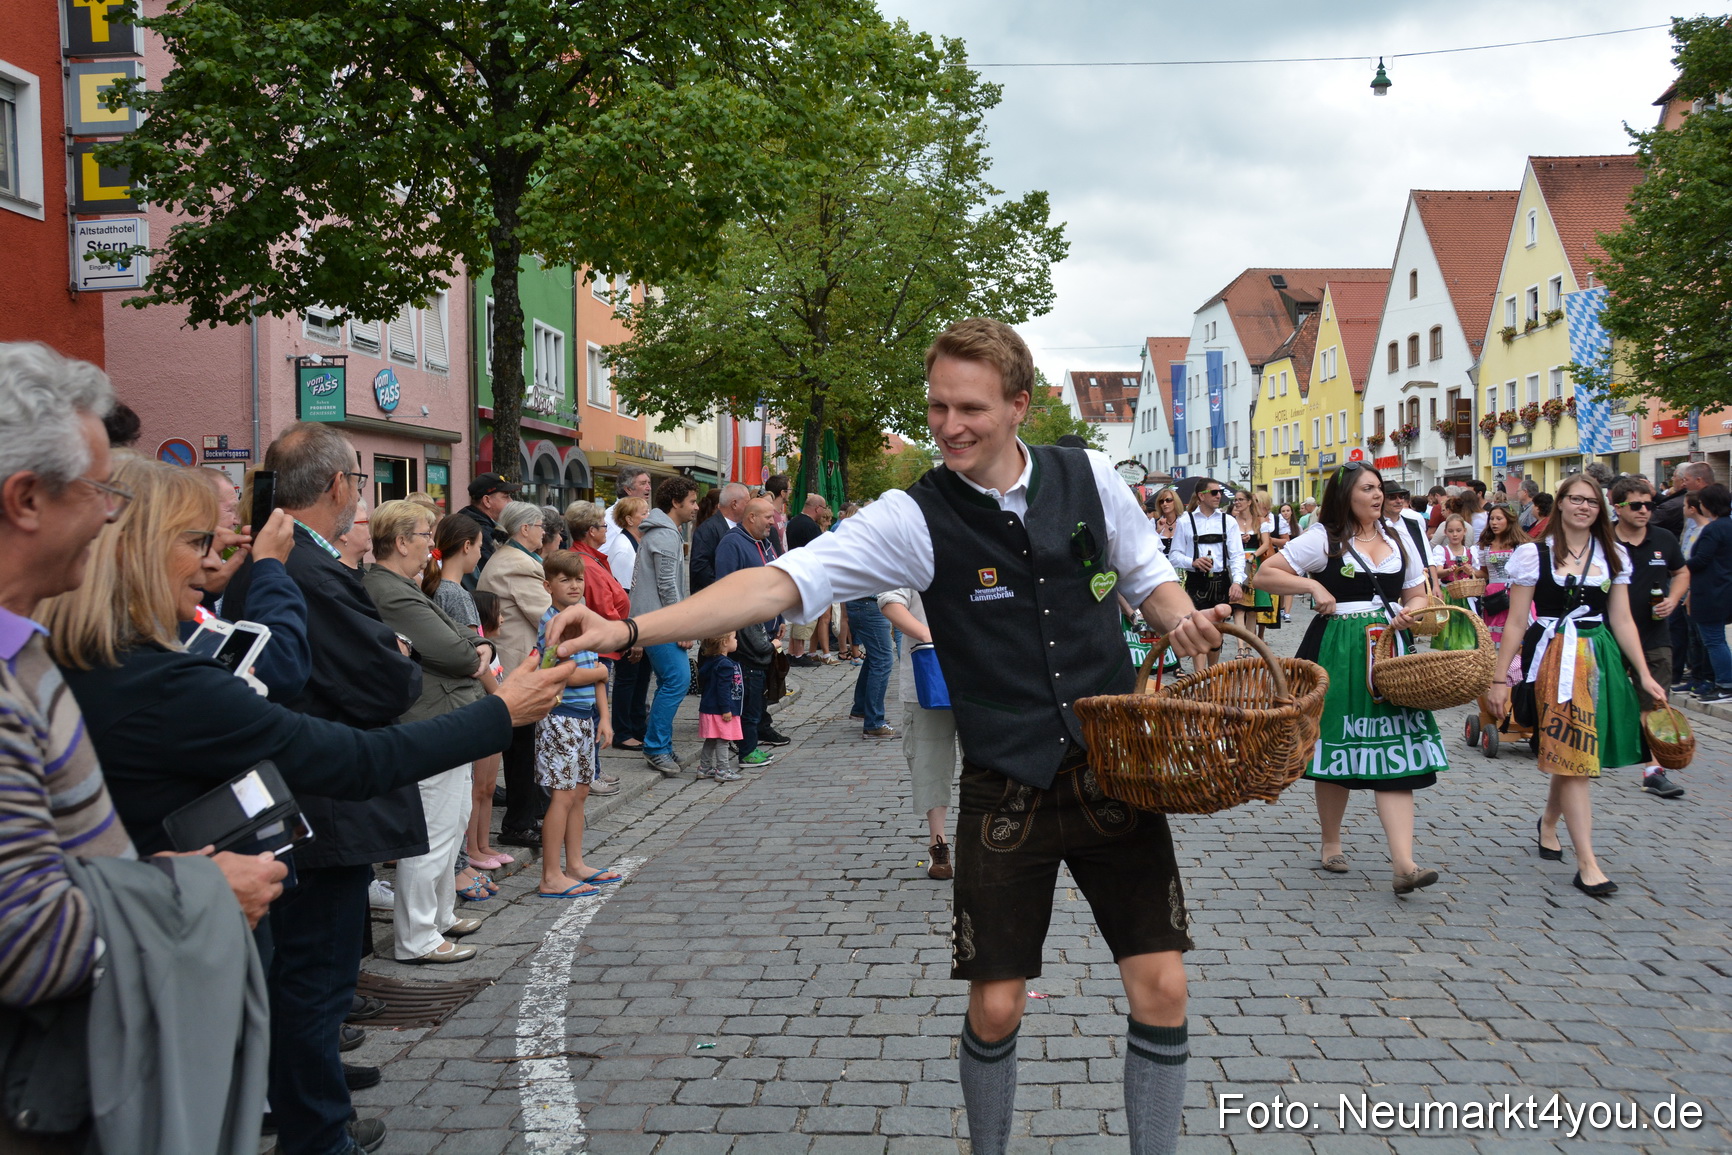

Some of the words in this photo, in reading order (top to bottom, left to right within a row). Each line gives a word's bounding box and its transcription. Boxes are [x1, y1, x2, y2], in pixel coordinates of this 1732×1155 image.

[79, 224, 135, 236] Altstadthotel
[87, 240, 128, 253] Stern
[312, 379, 338, 396] FASS
[379, 383, 400, 406] FASS
[205, 450, 249, 459] Bockwirtsgasse
[1495, 449, 1504, 462] P
[974, 585, 1008, 594] Neumarkter
[970, 590, 1014, 602] Lammsbräu
